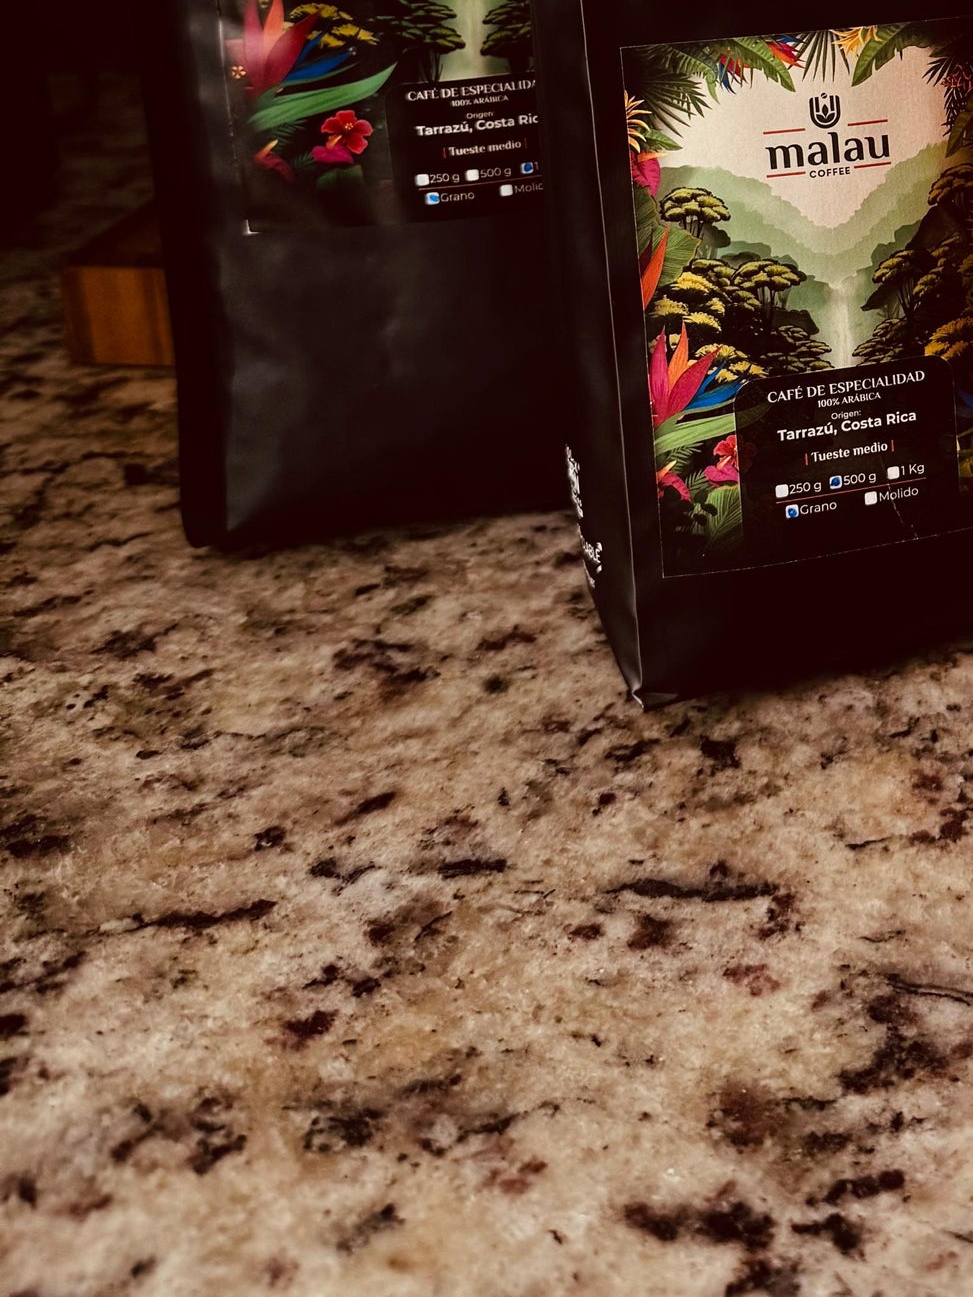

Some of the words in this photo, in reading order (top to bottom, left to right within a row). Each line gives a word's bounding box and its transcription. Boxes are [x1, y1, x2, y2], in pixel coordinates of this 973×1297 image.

[407, 87, 439, 102] CAFÉ
[441, 86, 459, 99] DE
[461, 79, 536, 97] ESPECIALID
[450, 98, 472, 108] 100%
[416, 121, 473, 136] Tarrazú,
[475, 116, 515, 131] Costa
[518, 113, 539, 125] Ric
[448, 145, 486, 157] Tueste
[488, 139, 522, 152] medio
[765, 131, 890, 170] malau
[430, 173, 450, 184] 250
[452, 173, 460, 183] g
[480, 167, 501, 178] 500
[504, 166, 512, 177] g
[810, 166, 850, 178] COFFEE
[440, 191, 475, 202] Grano
[514, 182, 545, 194] Moli
[767, 386, 803, 404] CAFÉ
[806, 384, 826, 398] DE
[829, 370, 925, 395] ESPECIALIDAD
[817, 397, 841, 408] 100%
[841, 392, 881, 405] ARÁBICA
[830, 409, 862, 421] Origen:
[777, 422, 838, 442] Tarrazú,
[840, 416, 883, 432] Costa
[886, 411, 917, 426] Rica
[811, 449, 850, 463] Tueste
[853, 441, 888, 456] medio
[789, 481, 811, 495] 250
[813, 481, 822, 493] g
[843, 473, 866, 486] 500
[868, 473, 877, 484] g
[908, 463, 925, 476] Kg
[800, 502, 837, 515] Grano
[879, 486, 919, 502] Molido
